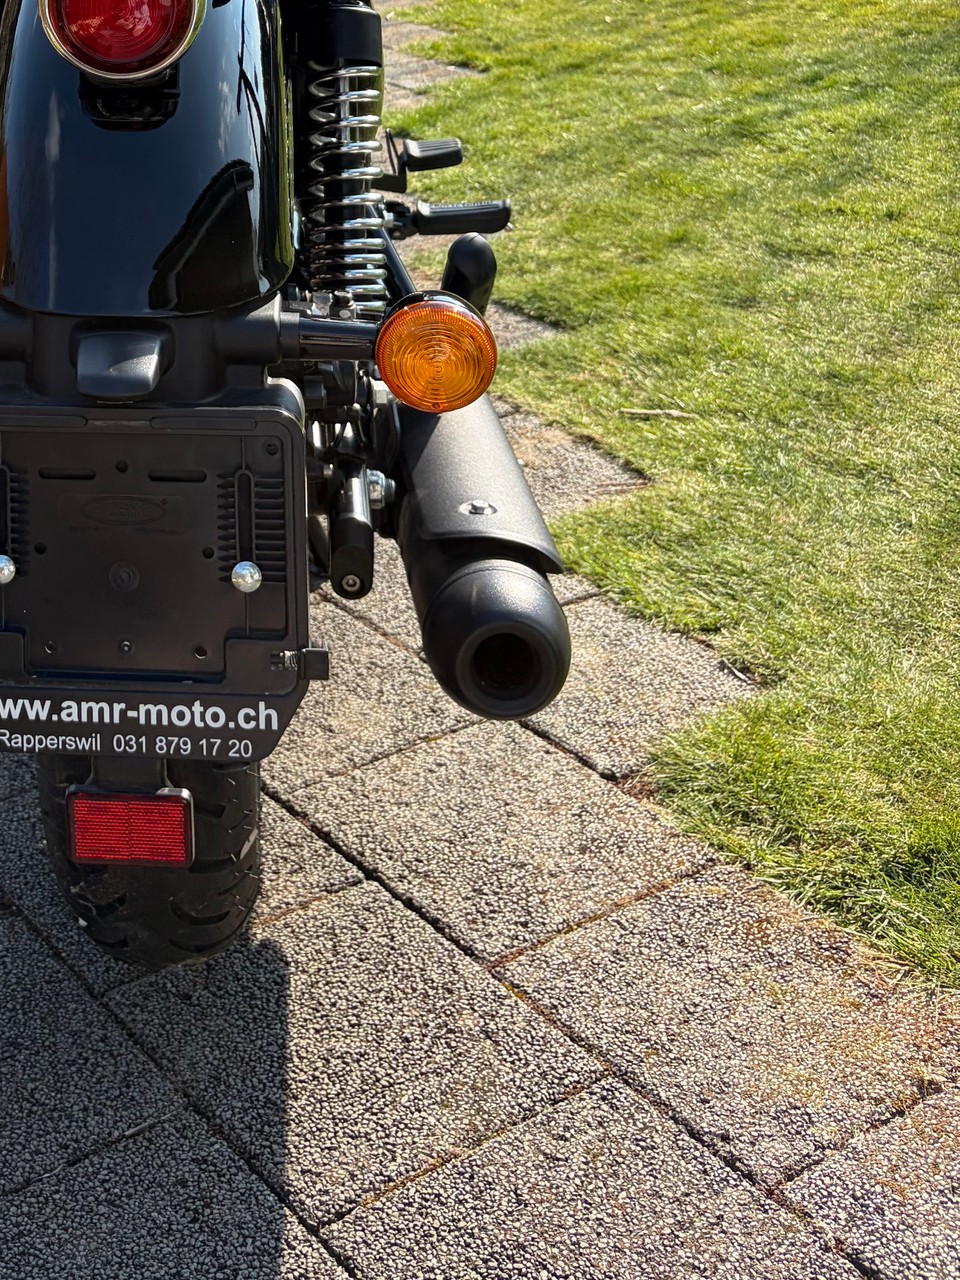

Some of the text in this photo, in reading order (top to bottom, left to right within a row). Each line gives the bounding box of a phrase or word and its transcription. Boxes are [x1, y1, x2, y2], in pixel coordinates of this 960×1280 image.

[113, 734, 146, 753] 031
[155, 736, 192, 755] 879
[199, 737, 222, 756] 17
[228, 739, 253, 758] 20
